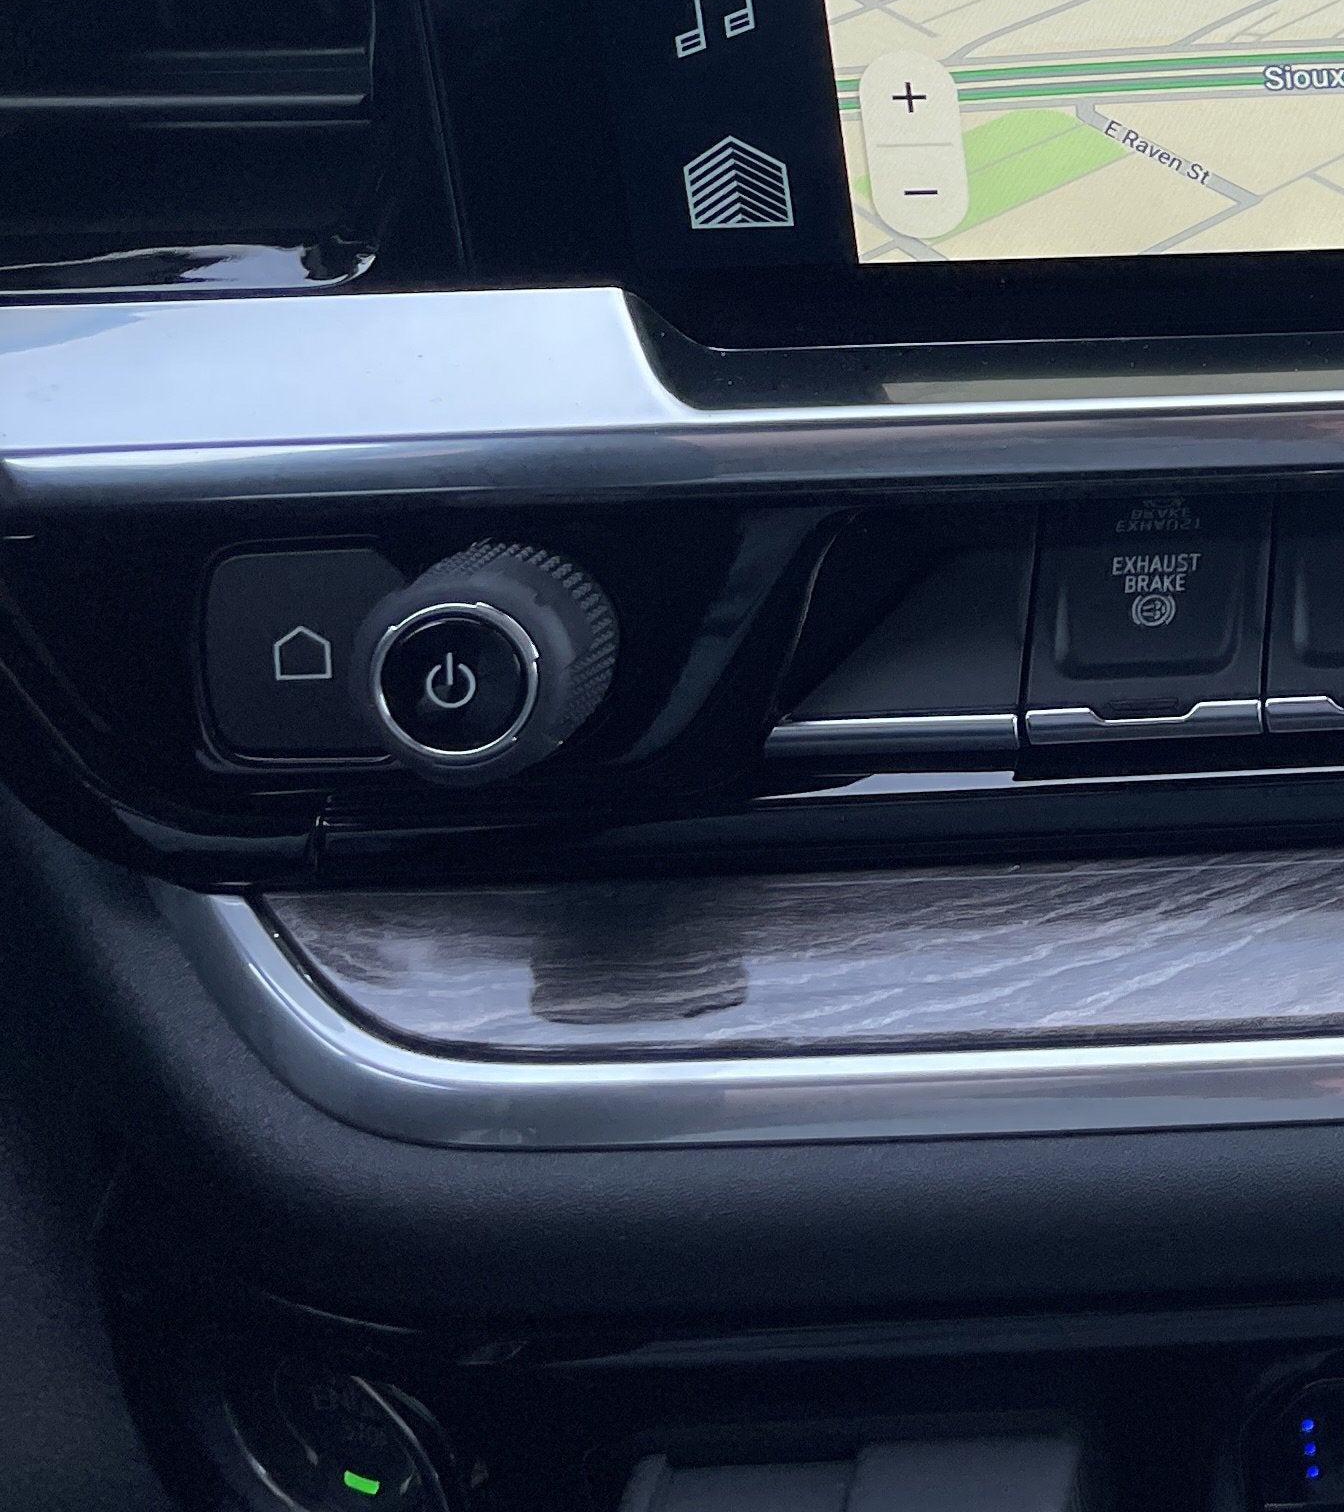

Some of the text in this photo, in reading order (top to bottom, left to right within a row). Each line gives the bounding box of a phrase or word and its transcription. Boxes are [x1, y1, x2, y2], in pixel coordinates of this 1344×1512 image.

[1103, 120, 1211, 185] E Raven St
[1112, 554, 1202, 575] EXHAUST
[1124, 574, 1187, 592] BRAKE
